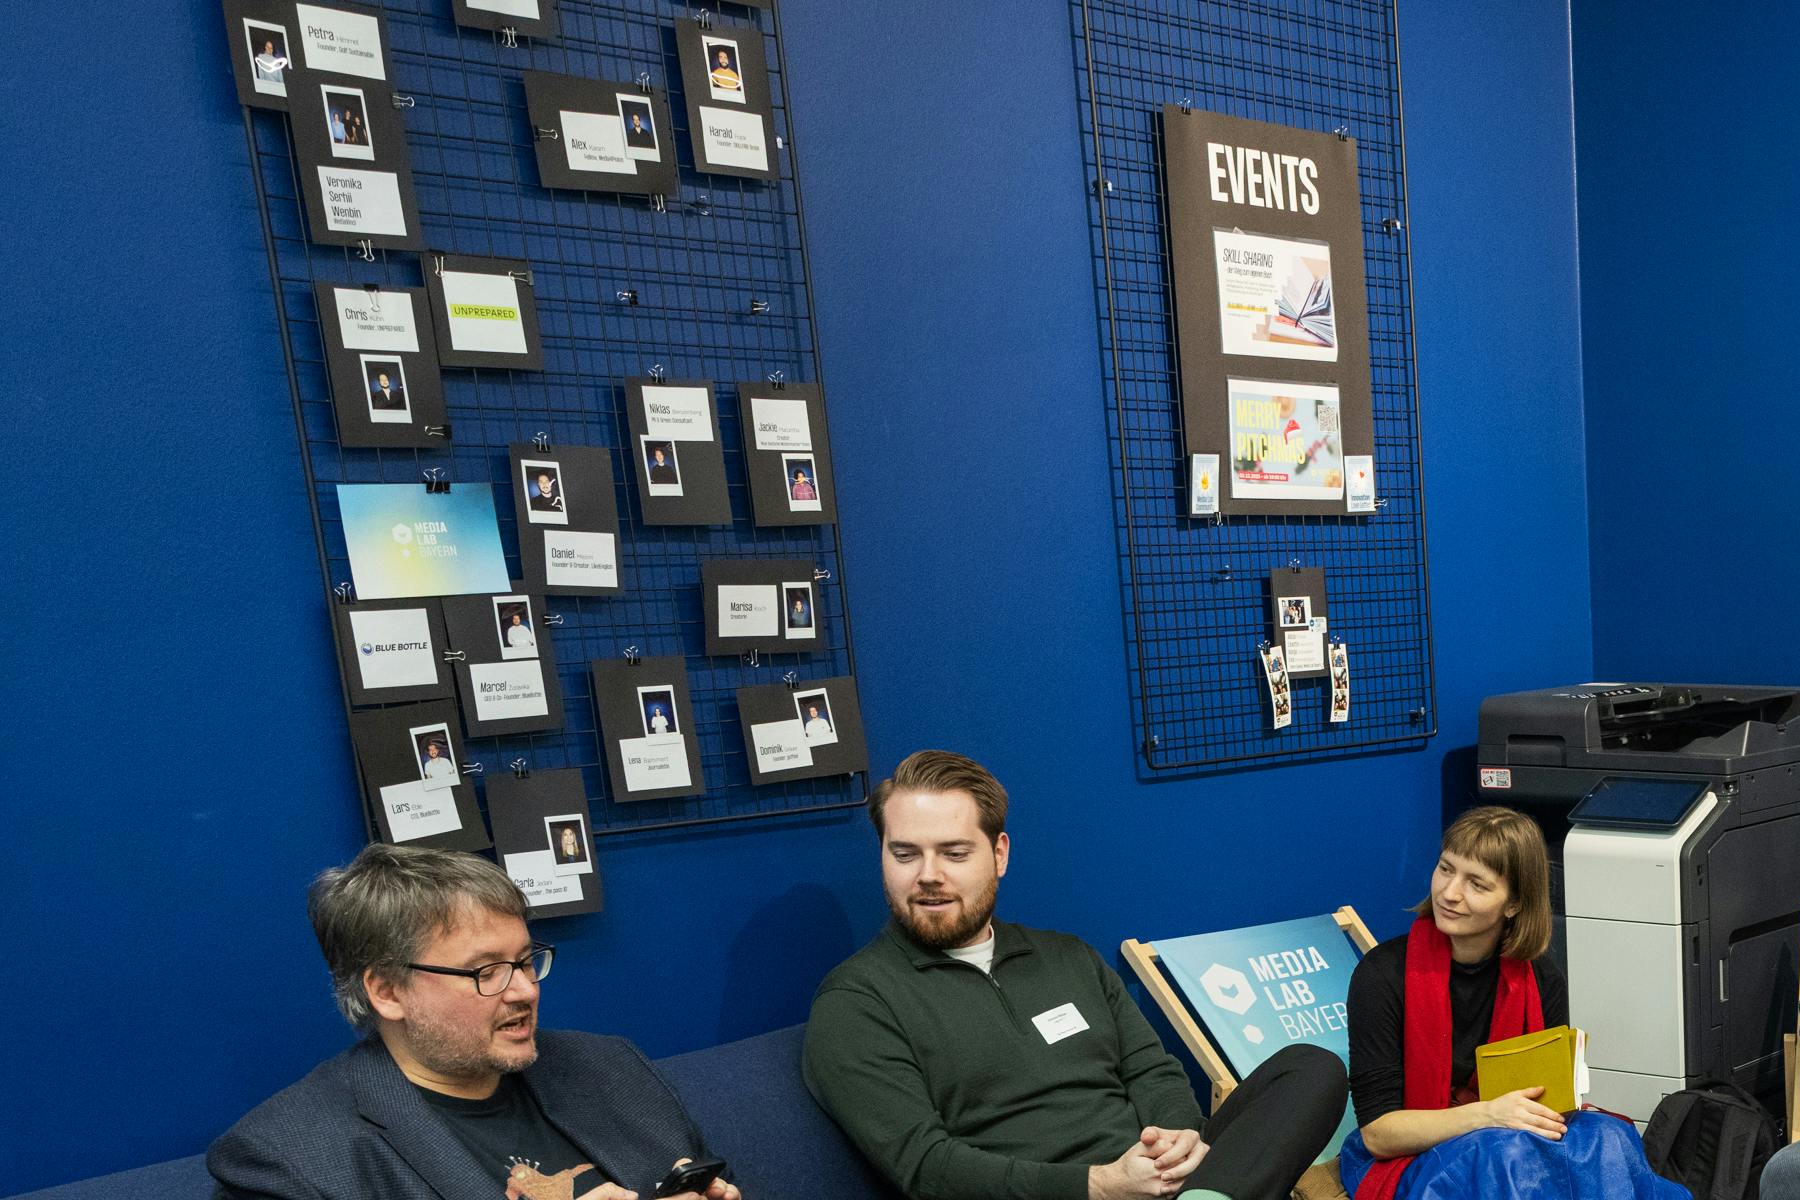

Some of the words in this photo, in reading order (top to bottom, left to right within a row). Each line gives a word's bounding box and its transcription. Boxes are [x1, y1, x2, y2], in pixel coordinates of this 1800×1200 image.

[308, 25, 335, 41] Petra
[709, 125, 733, 139] Harald
[571, 138, 588, 150] Alex
[326, 175, 362, 190] Veronika
[1207, 141, 1320, 215] EVENTS
[331, 204, 362, 218] Wenbin
[1223, 247, 1242, 264] SKILL
[1243, 250, 1274, 268] SHARING
[345, 307, 368, 321] Chris
[453, 306, 516, 320] UNPREPARED
[649, 403, 671, 415] Niklas
[1236, 399, 1282, 430] MERRY
[758, 422, 778, 432] Jackie
[1236, 431, 1306, 465] PITCHMAS
[414, 521, 449, 535] MEDIA
[416, 534, 438, 546] LAB
[419, 545, 458, 559] BAYERN
[551, 547, 575, 559] Daniel
[730, 601, 753, 611] Marisa
[375, 643, 397, 652] BLUE
[397, 641, 428, 651] BOTTLE
[480, 681, 507, 693] Marcel
[759, 743, 784, 756] Dominik
[391, 802, 411, 815] Lars
[515, 877, 534, 889] Carla
[1247, 946, 1330, 982] MEDIA
[1263, 979, 1316, 1011] LAB
